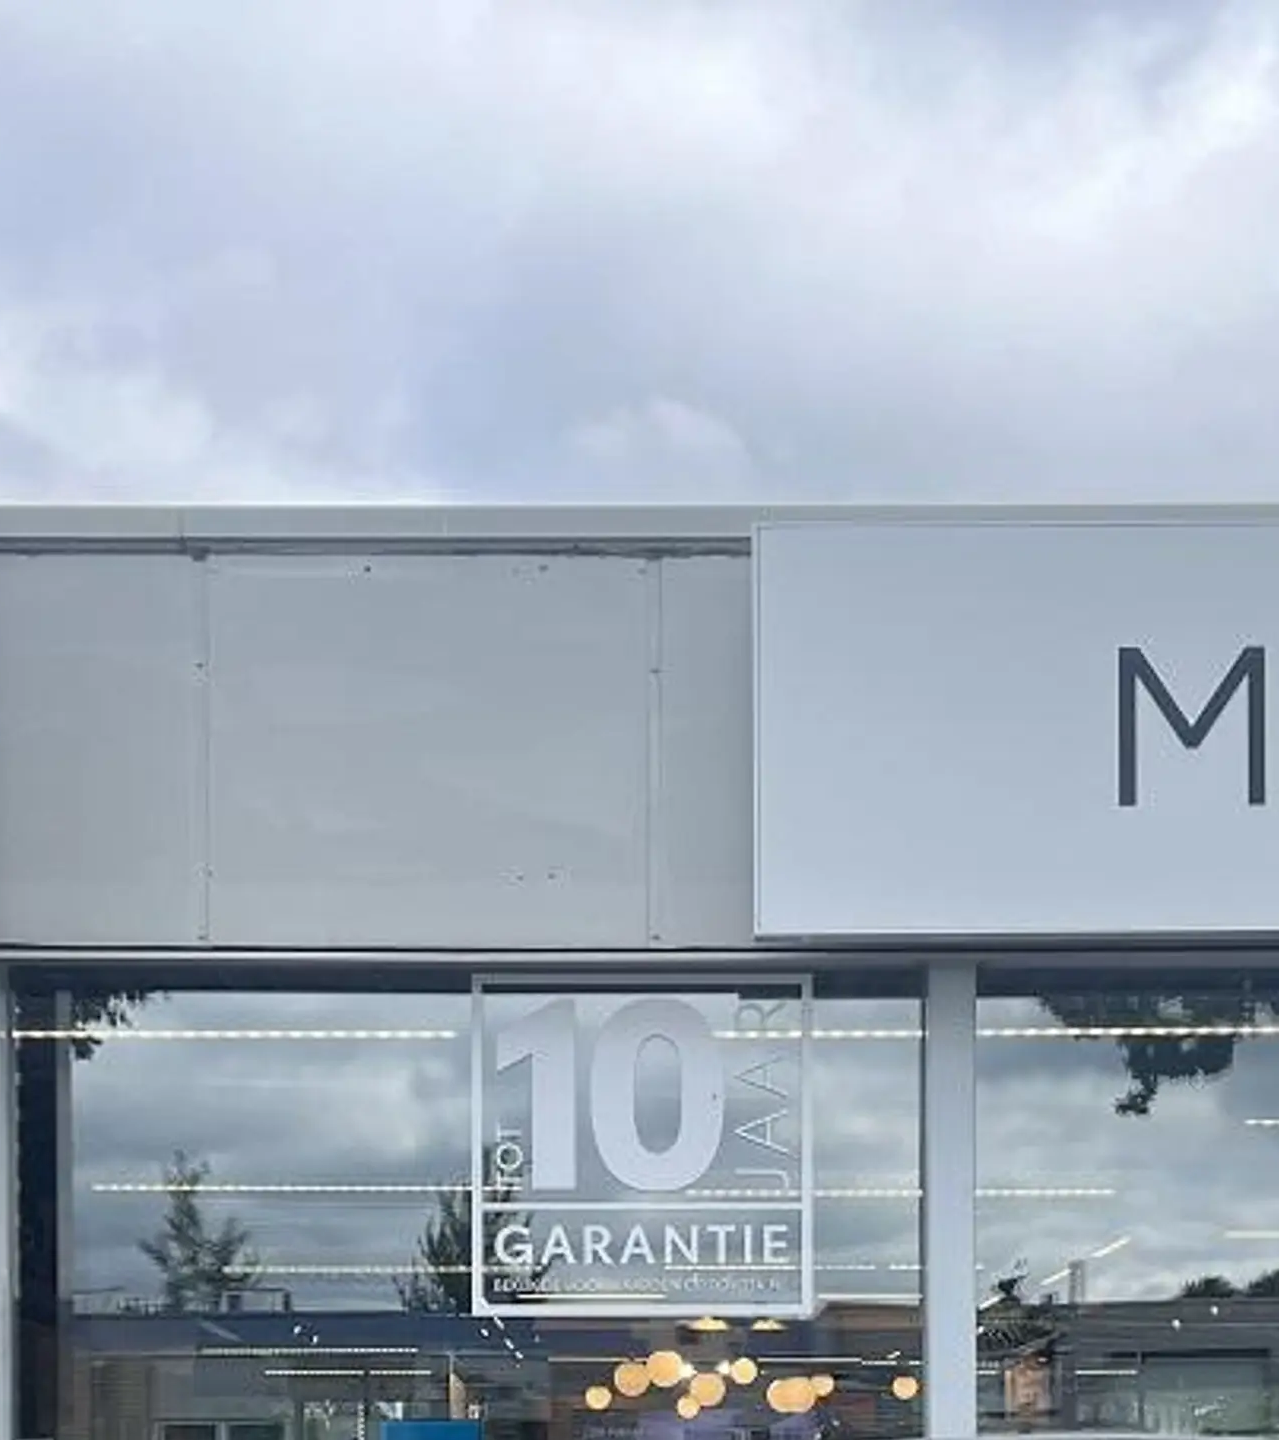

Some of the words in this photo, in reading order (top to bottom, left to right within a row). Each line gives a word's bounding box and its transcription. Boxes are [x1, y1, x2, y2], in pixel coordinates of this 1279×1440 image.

[495, 997, 725, 1192] 10
[734, 1001, 790, 1190] JAAR
[494, 1223, 791, 1266] GARANTIE
